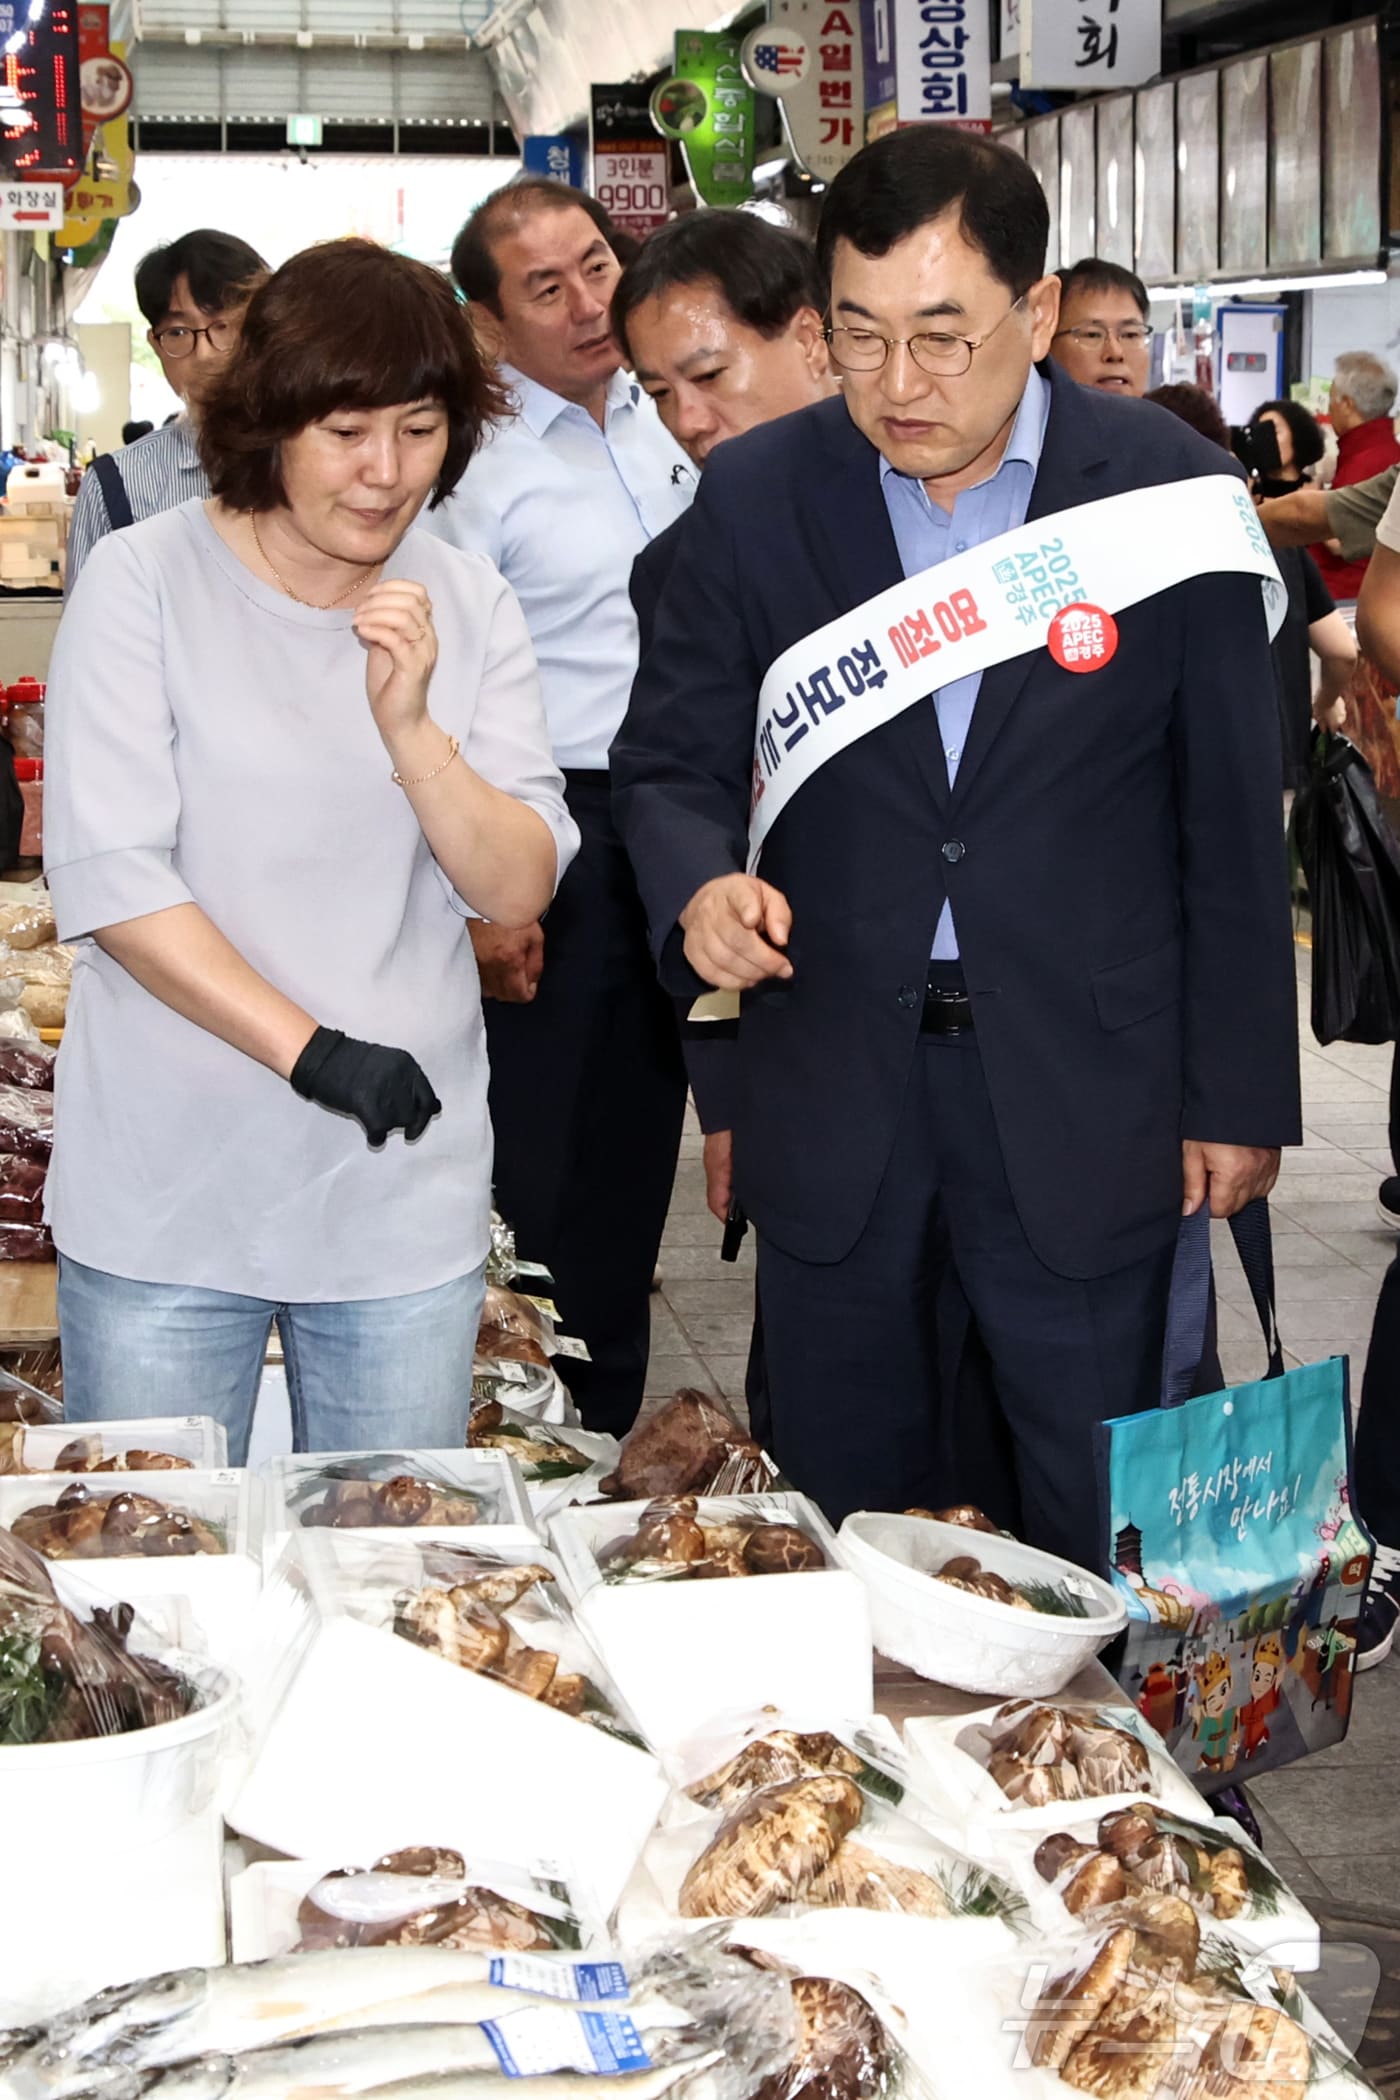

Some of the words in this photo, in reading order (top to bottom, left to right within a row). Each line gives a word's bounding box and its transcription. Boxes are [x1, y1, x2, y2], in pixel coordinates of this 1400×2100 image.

[819, 0, 854, 145] A일번가
[606, 158, 654, 178] 3인분
[7, 190, 56, 208] 화장실
[598, 184, 664, 211] 9900
[1014, 551, 1063, 620] APEC
[1039, 537, 1088, 604] 2025
[1006, 582, 1038, 626] 경주
[1061, 613, 1103, 633] 2025
[887, 588, 988, 669] 명절
[1062, 629, 1104, 648] APEC
[1079, 645, 1105, 660] 경주
[1168, 1450, 1273, 1527] 전통시장에서
[1230, 1473, 1302, 1543] 만나요!
